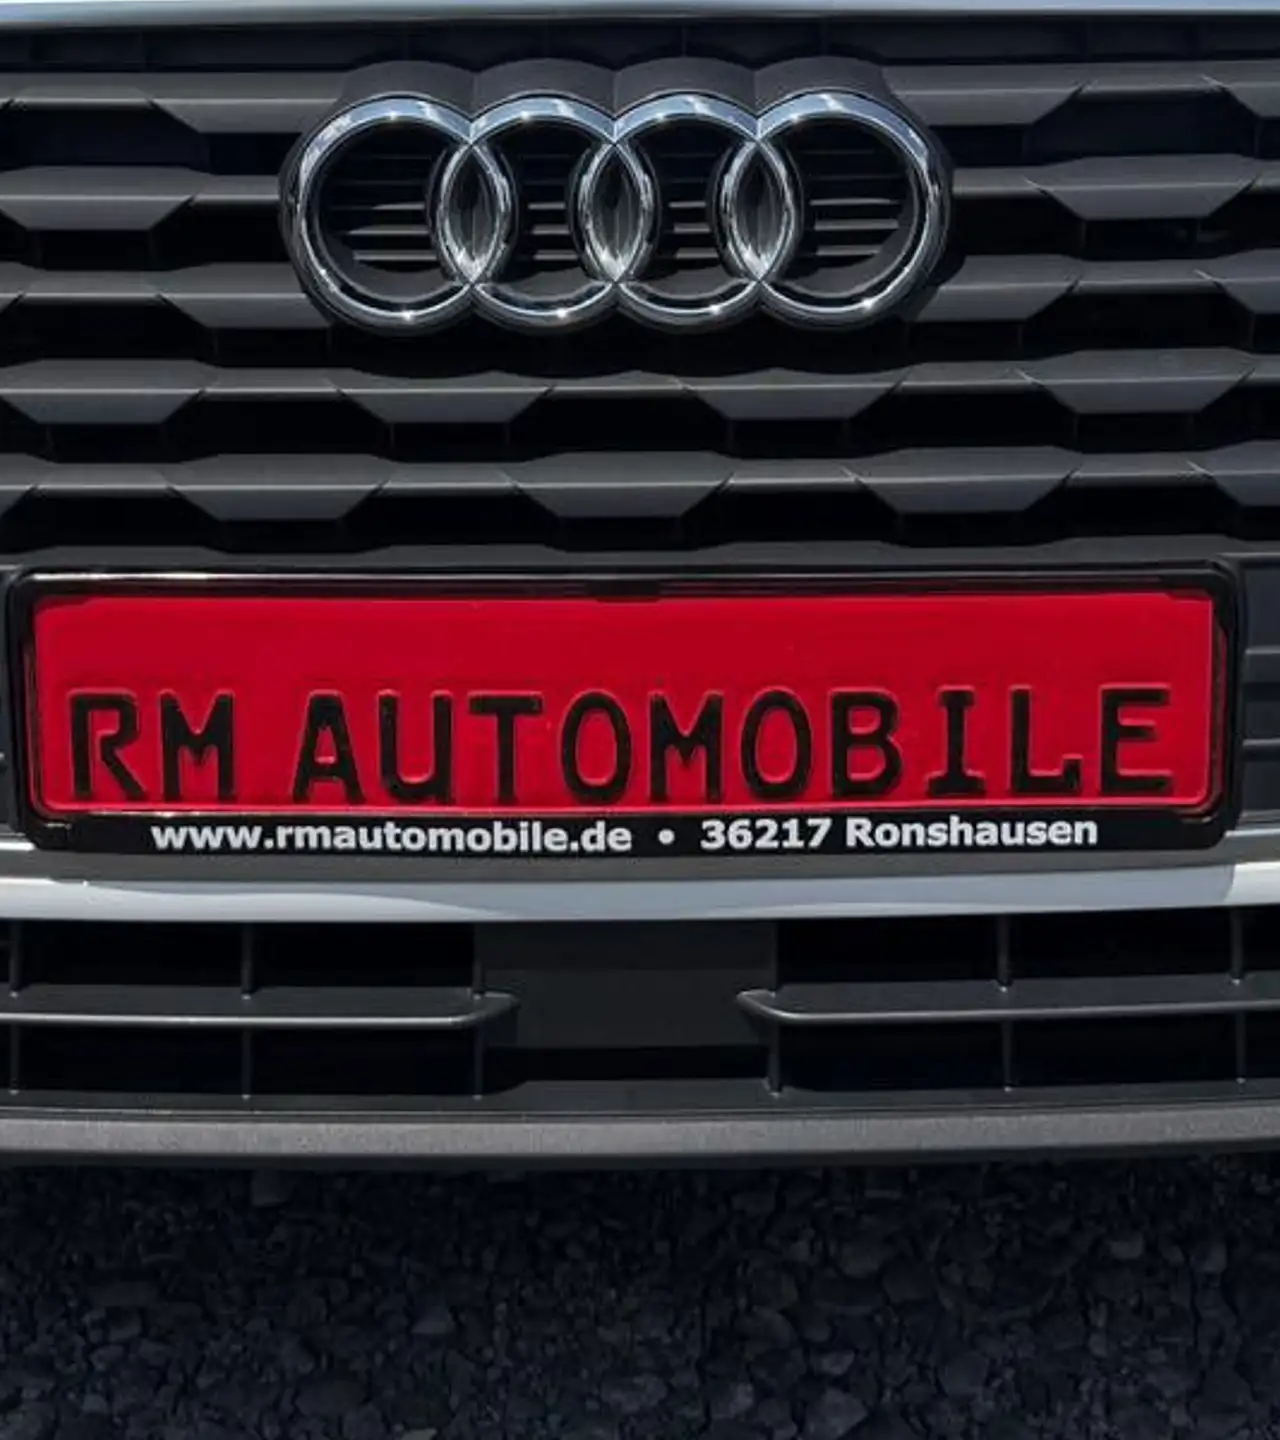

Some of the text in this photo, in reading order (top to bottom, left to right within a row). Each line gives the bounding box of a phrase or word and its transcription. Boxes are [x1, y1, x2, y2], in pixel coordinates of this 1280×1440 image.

[67, 685, 1173, 802] RM AUTOMOBILE
[150, 815, 1099, 853] www.rmautomobile.de 36217 Ronshausen
